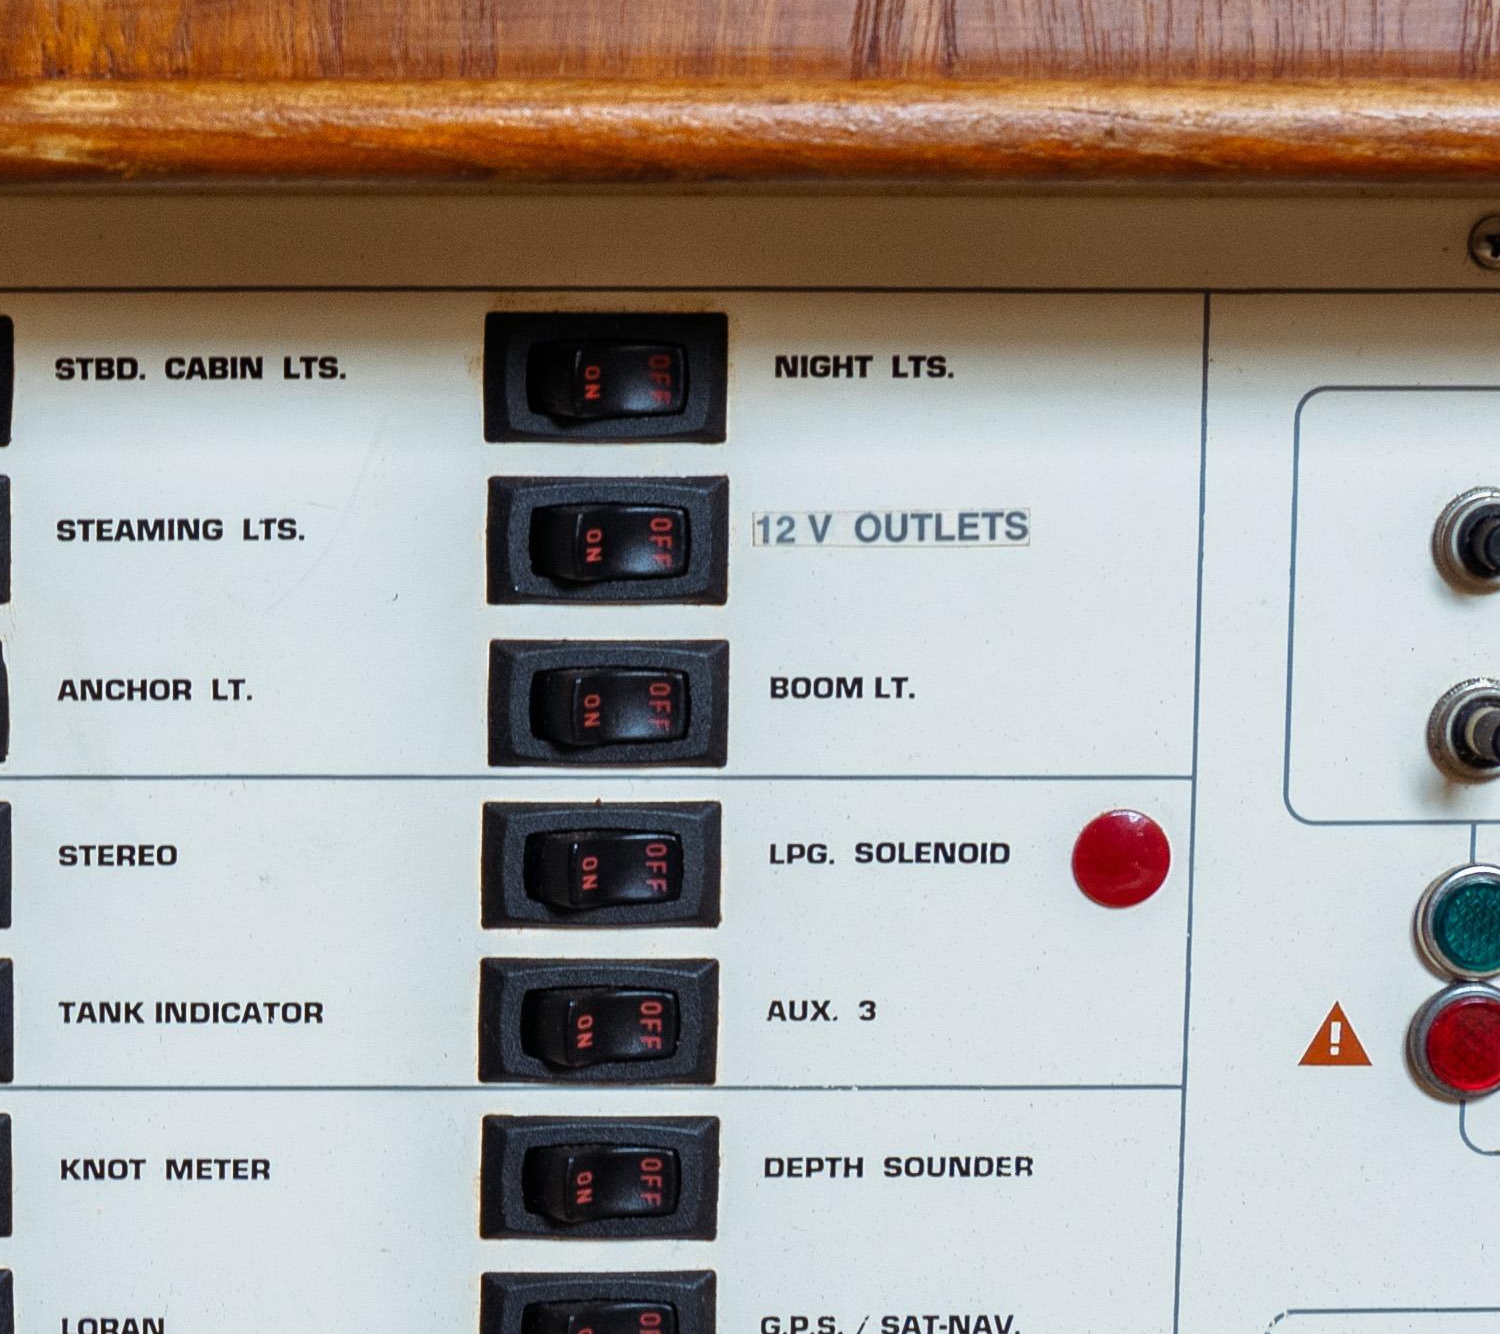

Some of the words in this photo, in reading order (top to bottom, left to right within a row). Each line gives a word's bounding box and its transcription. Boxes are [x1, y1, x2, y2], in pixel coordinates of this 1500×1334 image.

[54, 356, 146, 381] STBD.
[164, 356, 264, 380] CABIN
[283, 355, 346, 380] LTS.
[774, 354, 874, 379] NIGHT
[891, 354, 954, 379] LTS.
[56, 518, 224, 542] STEAMING
[243, 517, 305, 541] LTS.
[756, 515, 796, 544] 12
[808, 514, 832, 544] V
[854, 512, 1029, 543] OUTLETS
[57, 679, 192, 702] ANCHOR
[212, 678, 253, 701] LT.
[770, 676, 863, 700] BOOM
[874, 676, 915, 699] LT.
[58, 844, 178, 867] STEREO
[769, 843, 835, 865] LPG.
[855, 841, 1011, 864] SOLENOID
[58, 1001, 145, 1024] TANK
[155, 1001, 324, 1024] INDICATOR
[766, 1000, 838, 1022] AUX.
[858, 1000, 876, 1021] 3
[60, 1158, 147, 1181] KNOT
[165, 1158, 271, 1181] METER
[764, 1156, 864, 1178] DEPTH
[883, 1156, 1034, 1178] SOUNDER
